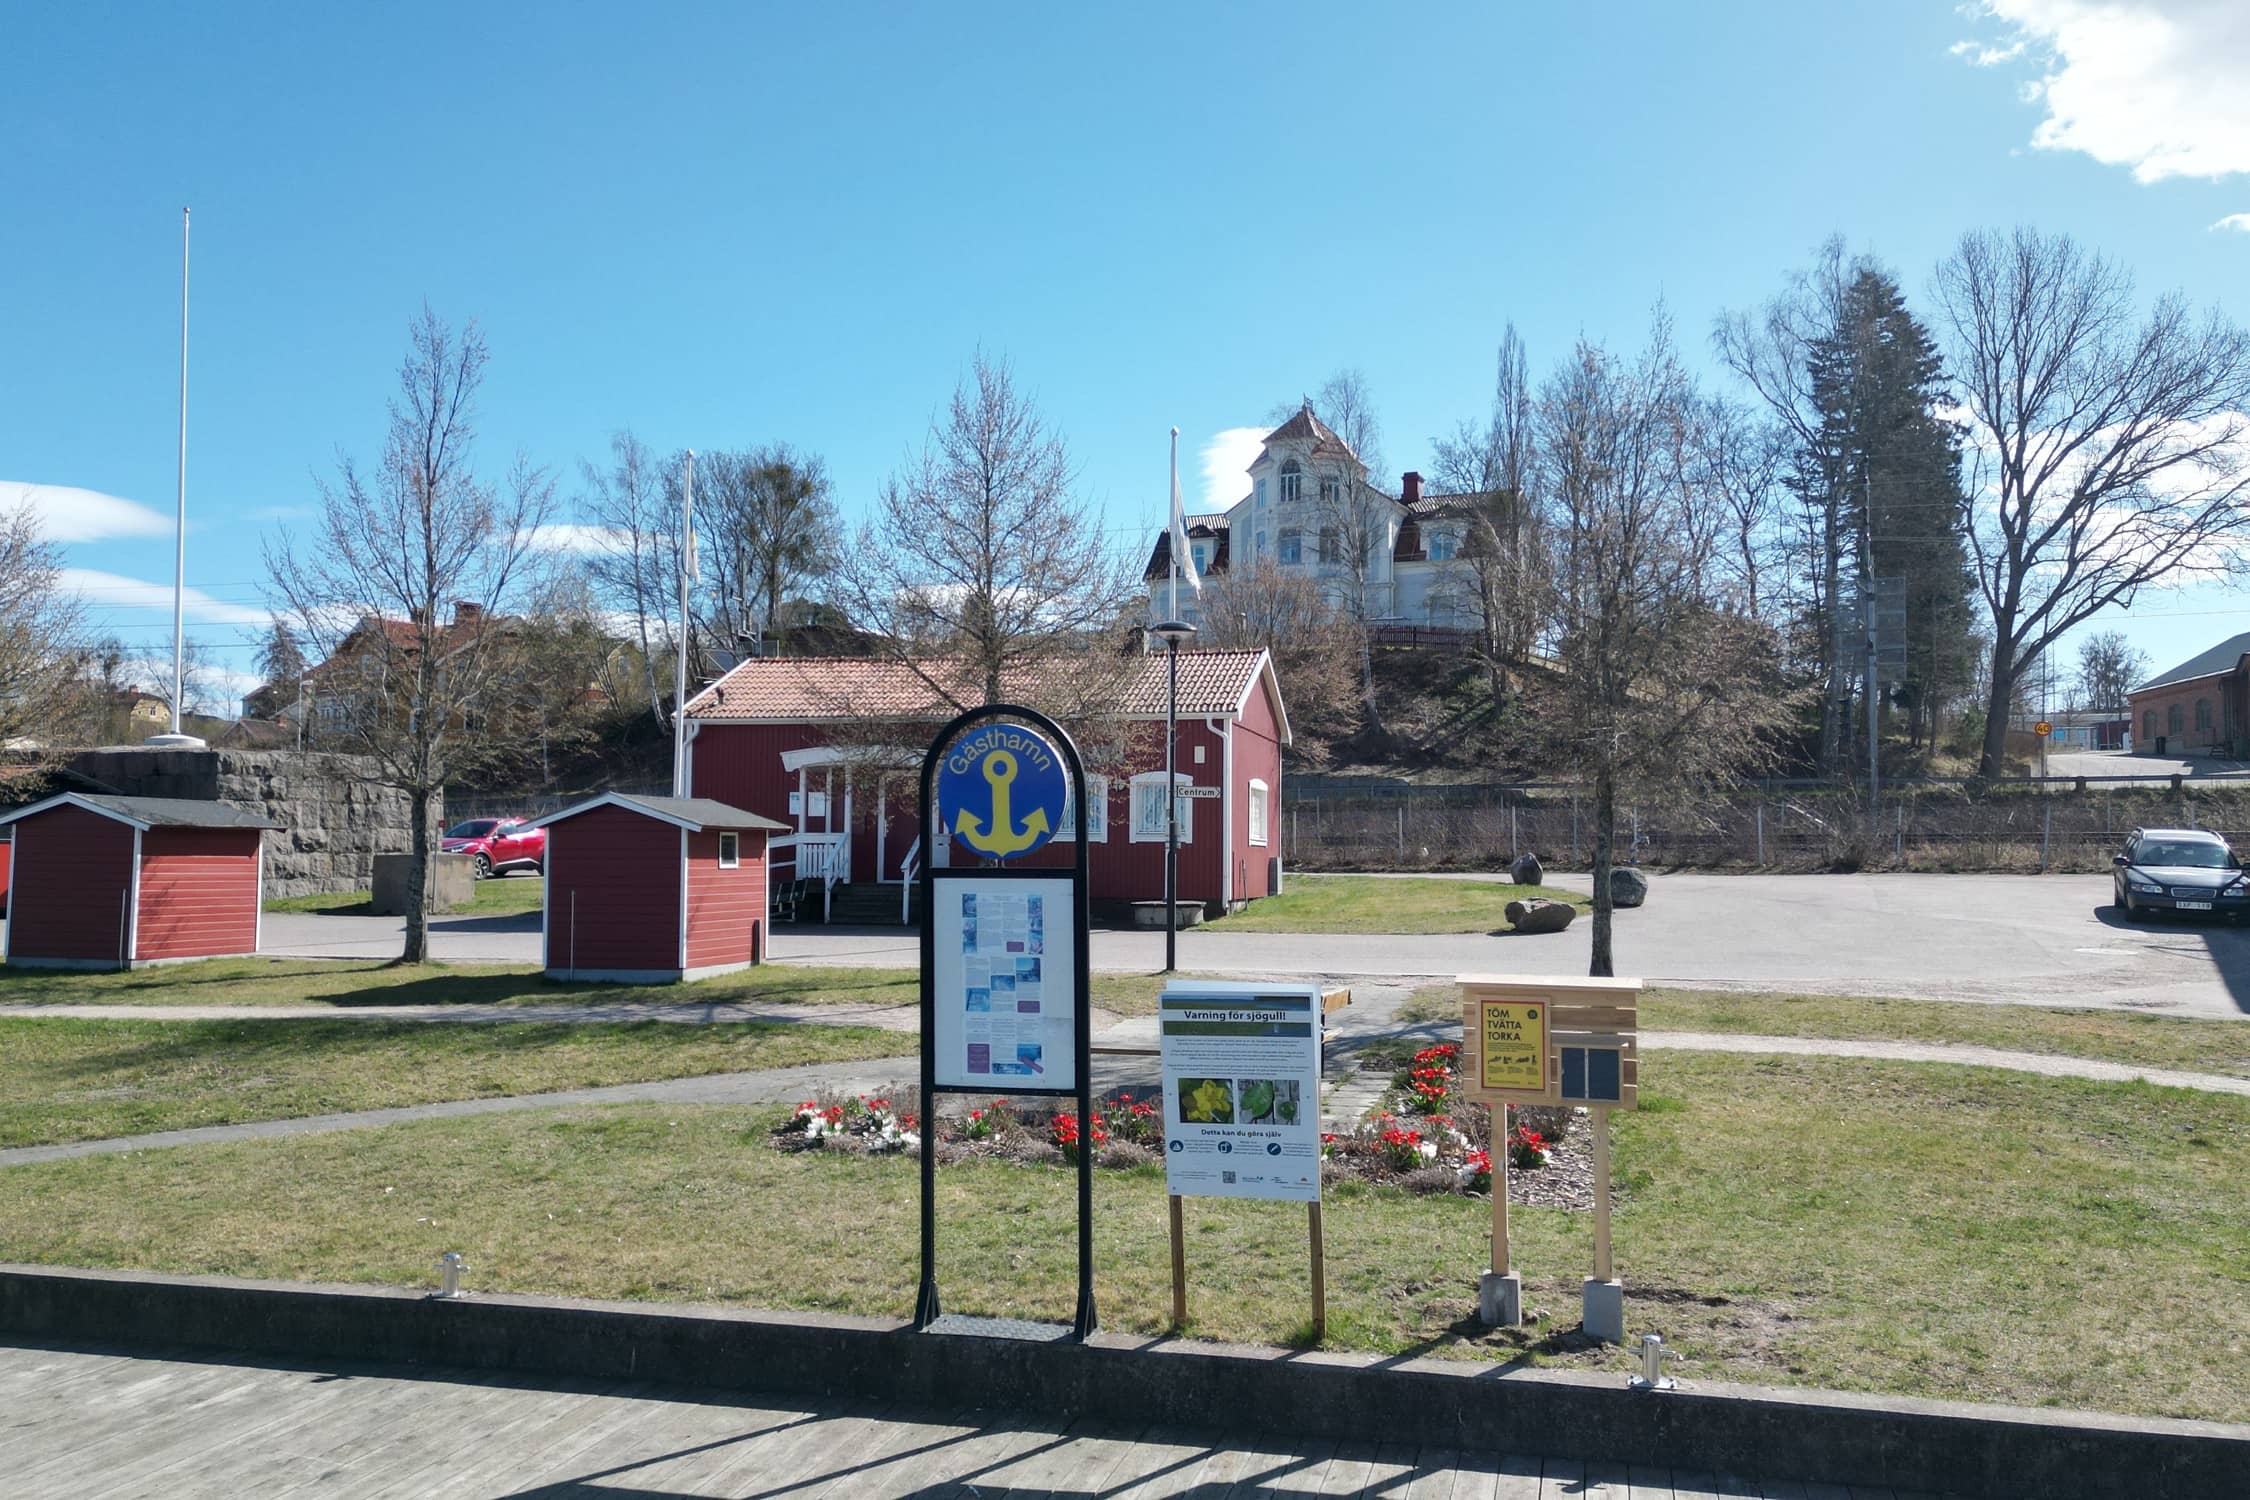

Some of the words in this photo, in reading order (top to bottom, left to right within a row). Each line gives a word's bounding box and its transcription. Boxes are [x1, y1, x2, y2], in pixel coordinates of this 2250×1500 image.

[949, 729, 1051, 775] Gästhamn
[1179, 788, 1215, 796] Centrum
[1184, 1010, 1226, 1021] Varning
[1228, 1011, 1244, 1020] för
[1246, 1012, 1286, 1022] sjögull!
[1487, 1008, 1510, 1018] TÖM
[1487, 1019, 1522, 1029] TVÄTTA
[1488, 1031, 1520, 1041] TORKA
[1222, 1129, 1235, 1137] kan
